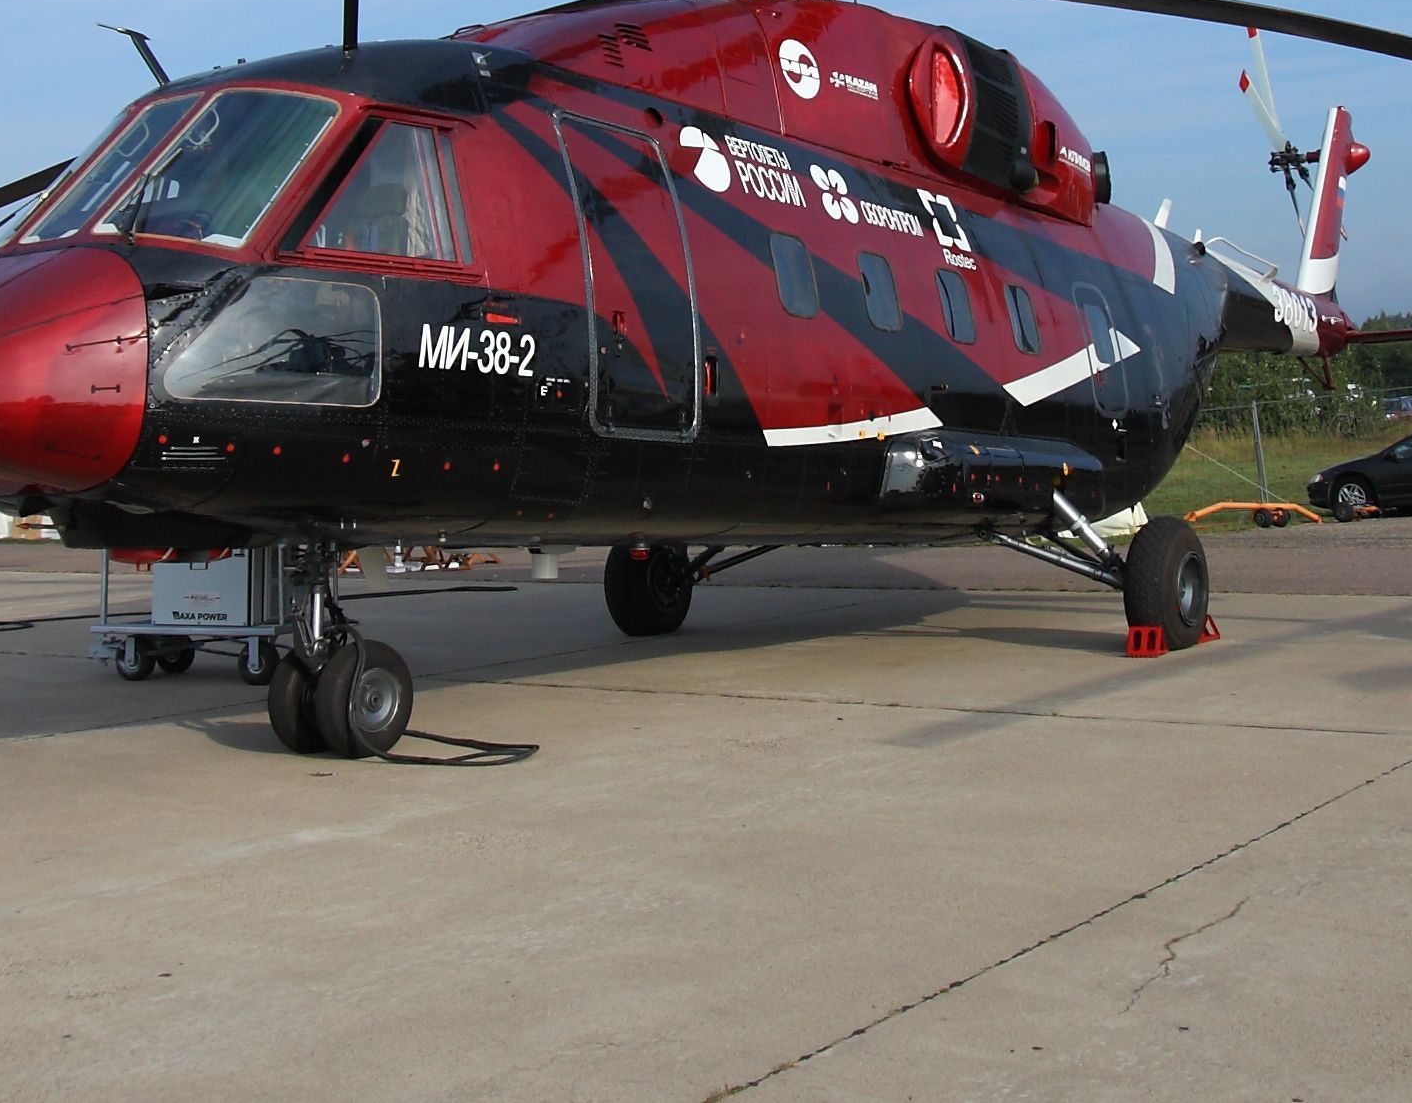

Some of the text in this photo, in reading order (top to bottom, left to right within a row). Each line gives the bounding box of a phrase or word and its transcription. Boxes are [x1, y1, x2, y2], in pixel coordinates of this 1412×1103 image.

[724, 134, 792, 171] ВЕРТОЛЕТЫ
[734, 160, 807, 208] РОССИИ
[942, 248, 977, 271] Rostec
[1272, 285, 1318, 333] 38013
[418, 323, 536, 377] МИ-38-2
[197, 613, 227, 621] POWER
